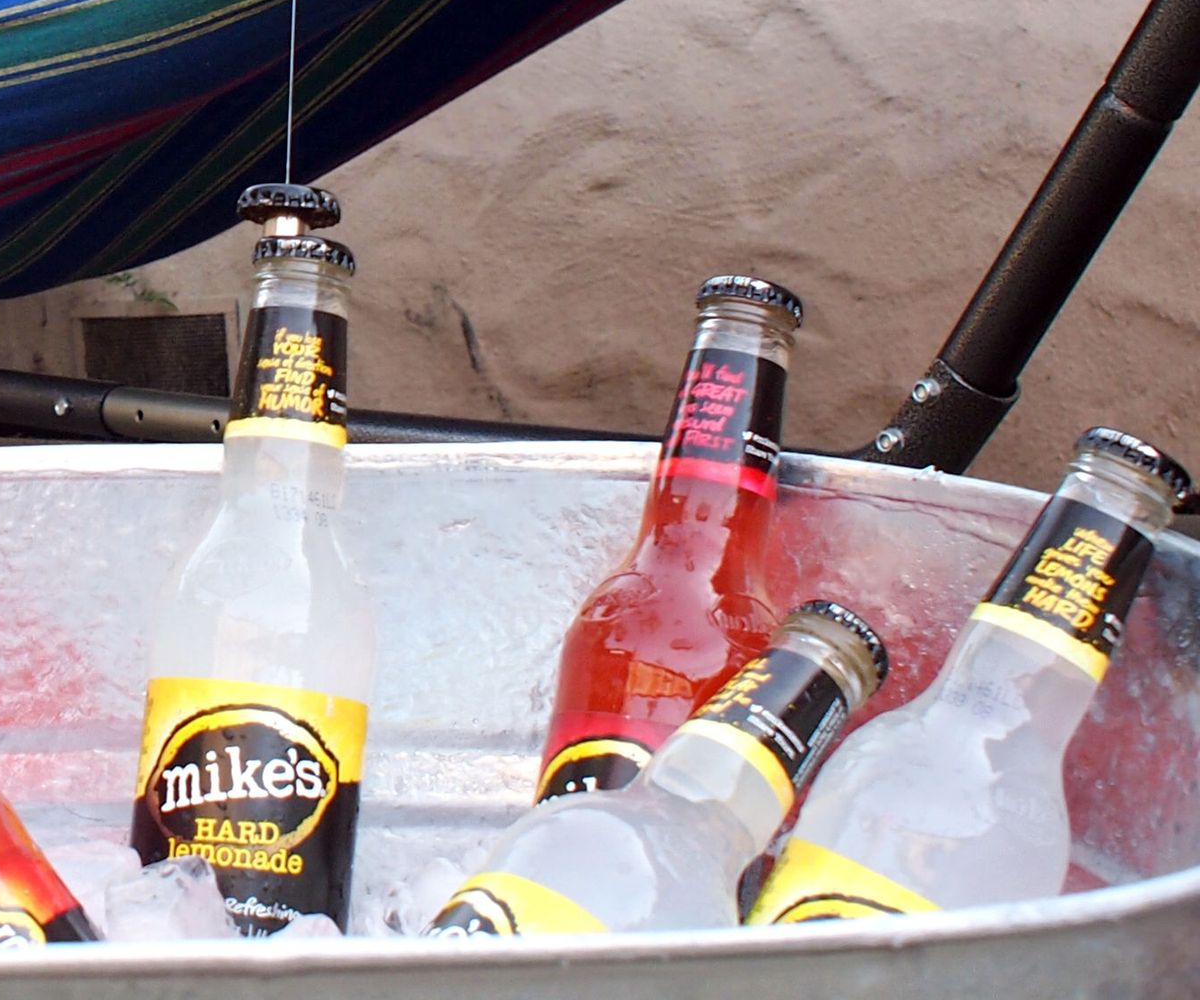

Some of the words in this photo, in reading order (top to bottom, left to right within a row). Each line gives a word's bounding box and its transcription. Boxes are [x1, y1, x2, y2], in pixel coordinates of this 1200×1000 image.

[274, 368, 316, 386] FIND
[259, 391, 324, 417] HUMOR
[1058, 537, 1110, 566] LIFE
[1035, 558, 1108, 601] LEMONS
[161, 747, 325, 812] mike's
[194, 818, 280, 845] HARD
[168, 838, 303, 875] lemonade
